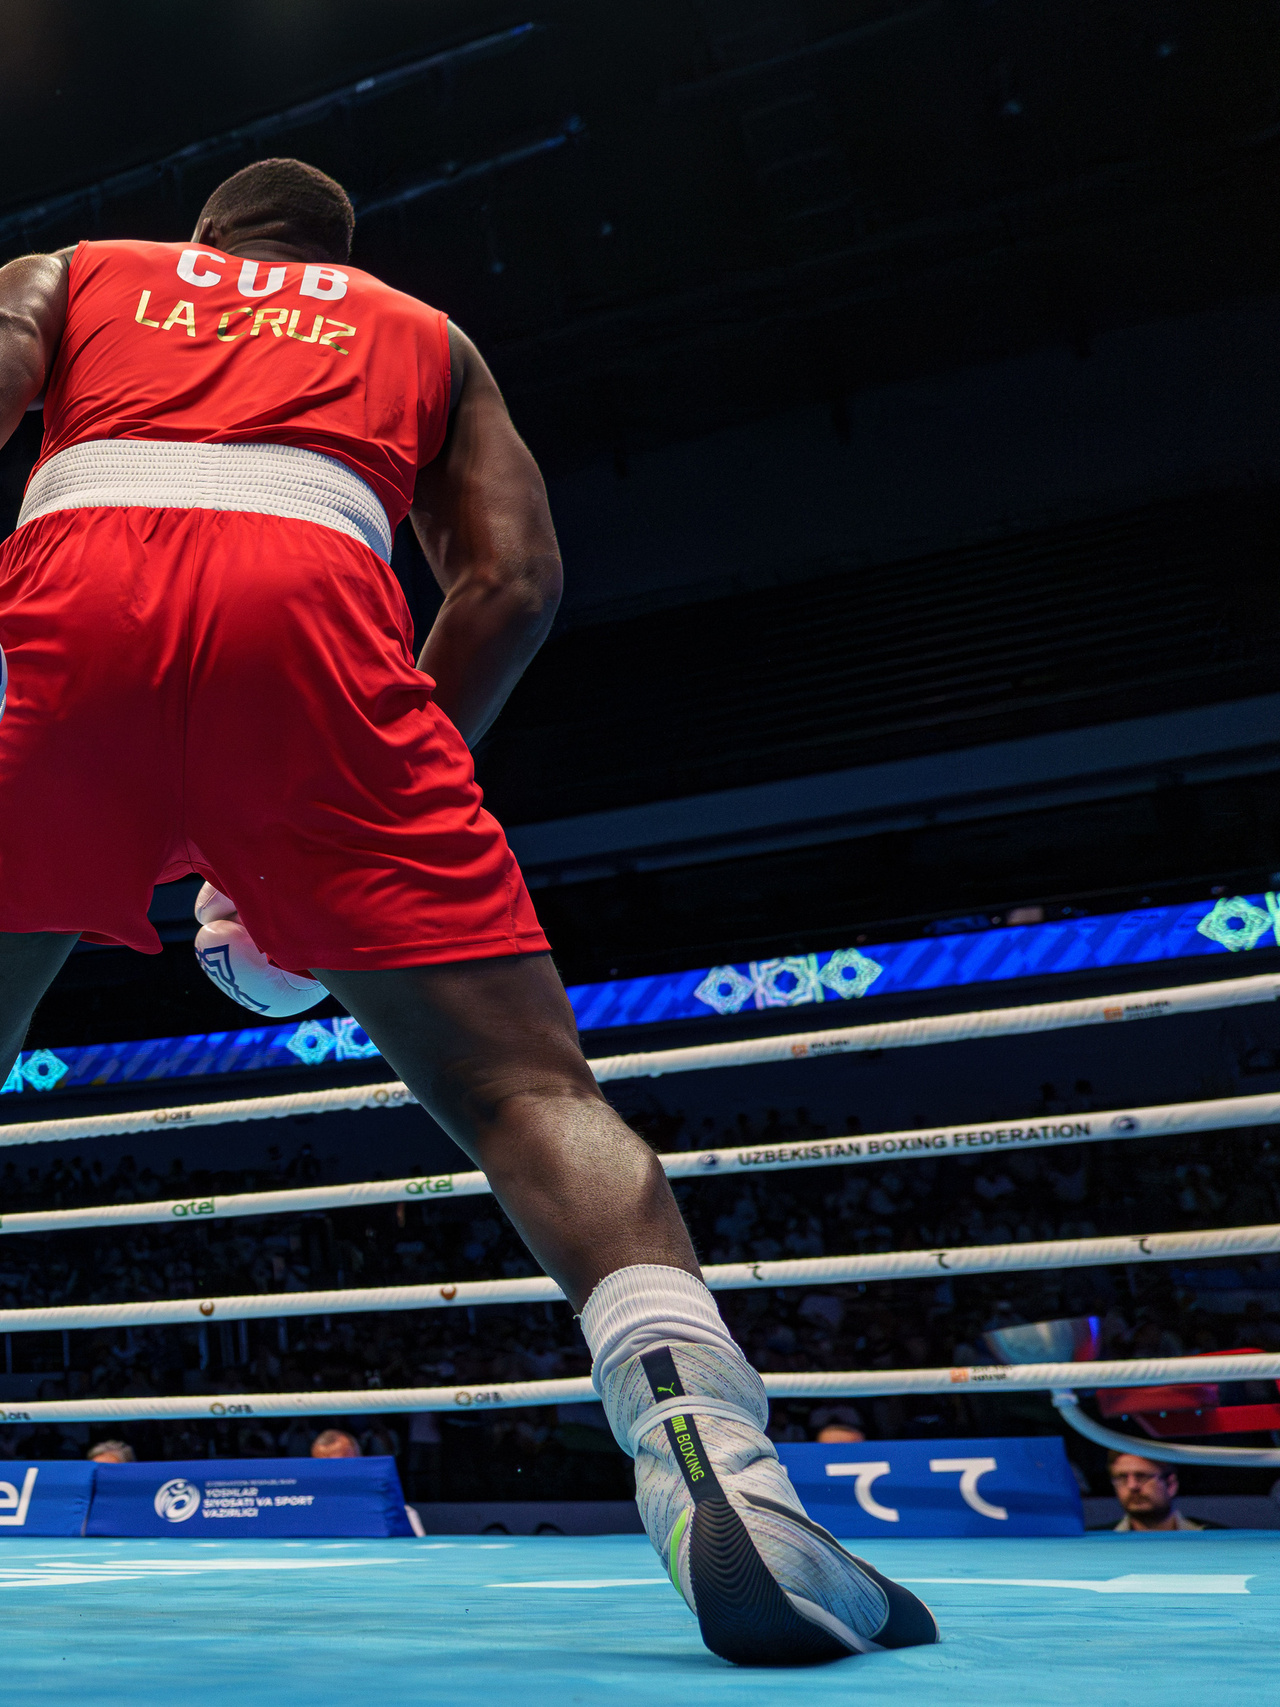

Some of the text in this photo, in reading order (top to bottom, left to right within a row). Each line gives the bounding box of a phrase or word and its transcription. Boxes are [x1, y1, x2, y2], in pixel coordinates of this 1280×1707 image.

[176, 249, 350, 301] CUB
[134, 289, 357, 356] LA CRUZ
[737, 1120, 1092, 1167] UZBEKISTAN BOXING FEDERATION
[172, 1198, 216, 1216] artel
[406, 1175, 453, 1195] artel
[676, 1433, 705, 1482] BOXING
[274, 1495, 314, 1507] SPORT
